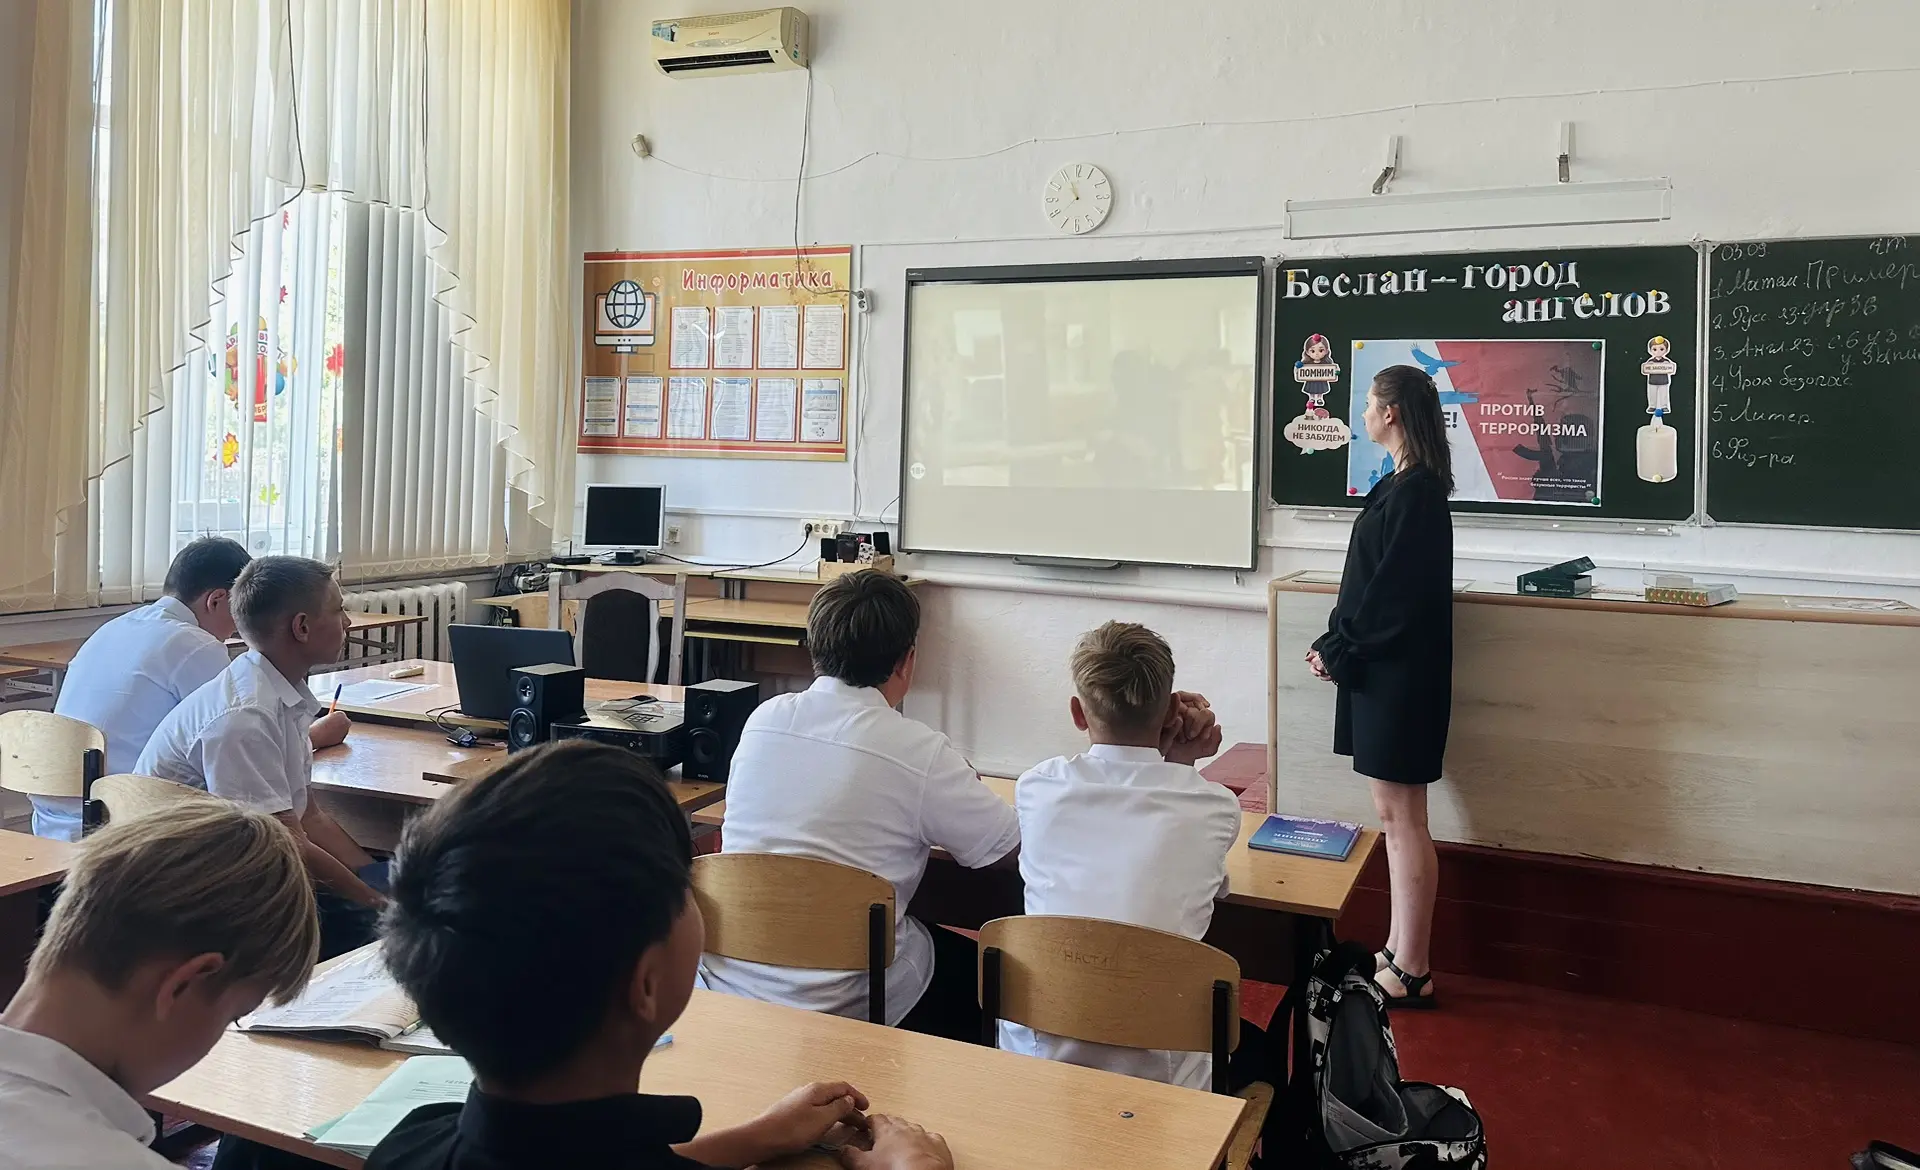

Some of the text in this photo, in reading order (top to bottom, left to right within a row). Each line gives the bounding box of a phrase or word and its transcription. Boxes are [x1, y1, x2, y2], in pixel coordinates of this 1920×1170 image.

[682, 268, 833, 295] Информатика
[1282, 268, 1428, 299] Беслан
[1461, 261, 1581, 292] город
[1502, 290, 1672, 323] ангелов
[1299, 368, 1334, 378] ПОМНИМ
[1480, 403, 1545, 417] ПРОТИВ
[1297, 423, 1340, 433] НИКОГДА
[1480, 422, 1588, 437] ТЕРРОРИЗМА
[1292, 432, 1345, 442] НЕ ЗАБУДЕМ
